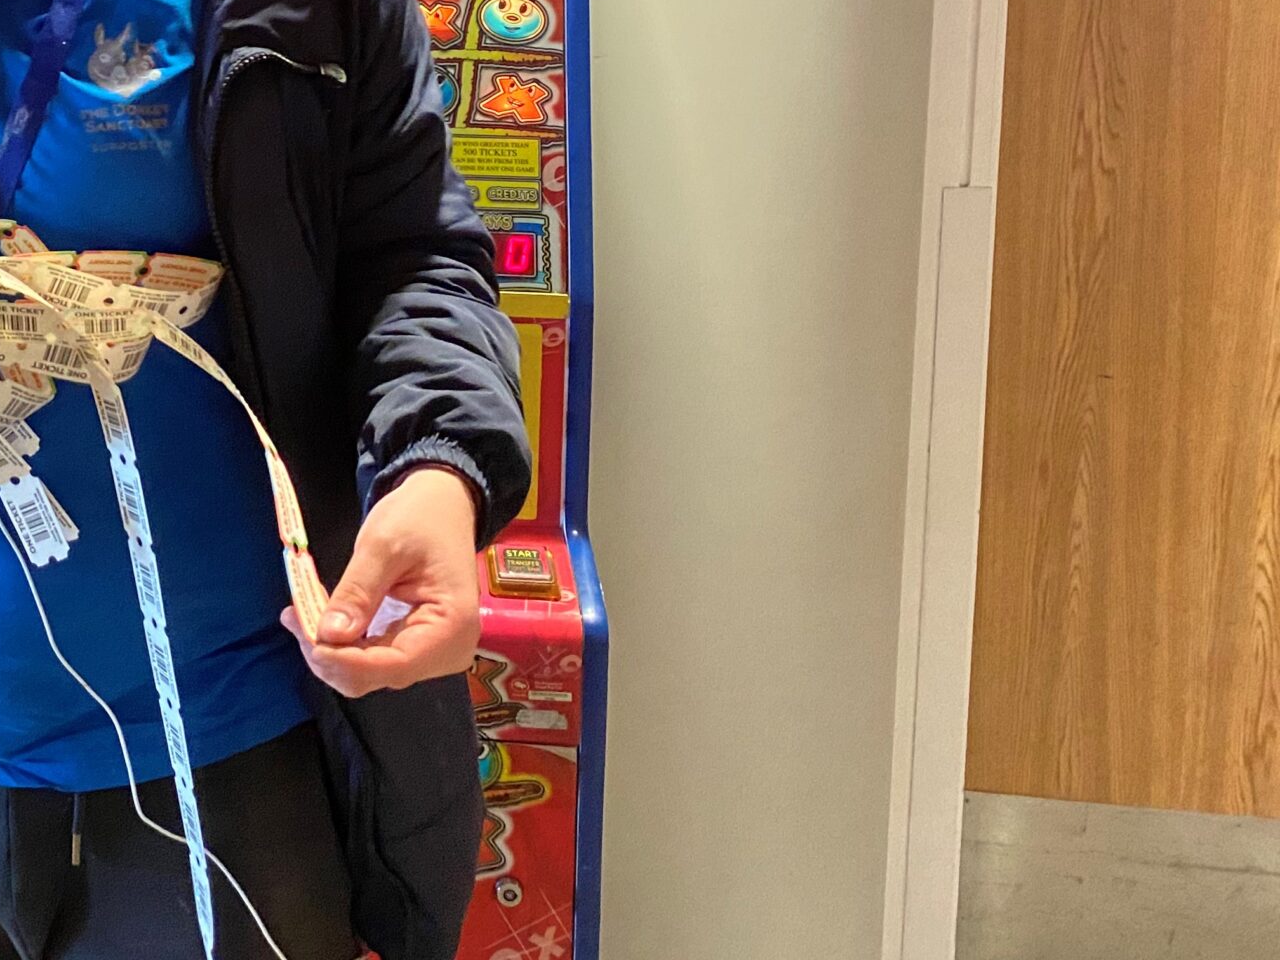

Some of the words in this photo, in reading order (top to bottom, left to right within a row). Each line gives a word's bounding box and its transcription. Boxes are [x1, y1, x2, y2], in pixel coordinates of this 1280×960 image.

[480, 148, 518, 157] TICKETS
[487, 188, 538, 202] CREDITS
[505, 235, 531, 272] 0
[10, 306, 45, 316] TICKET
[31, 362, 65, 376] TICKET
[66, 368, 88, 379] ONE
[7, 500, 26, 532] TICKET
[22, 530, 36, 554] ONE
[506, 549, 538, 559] START
